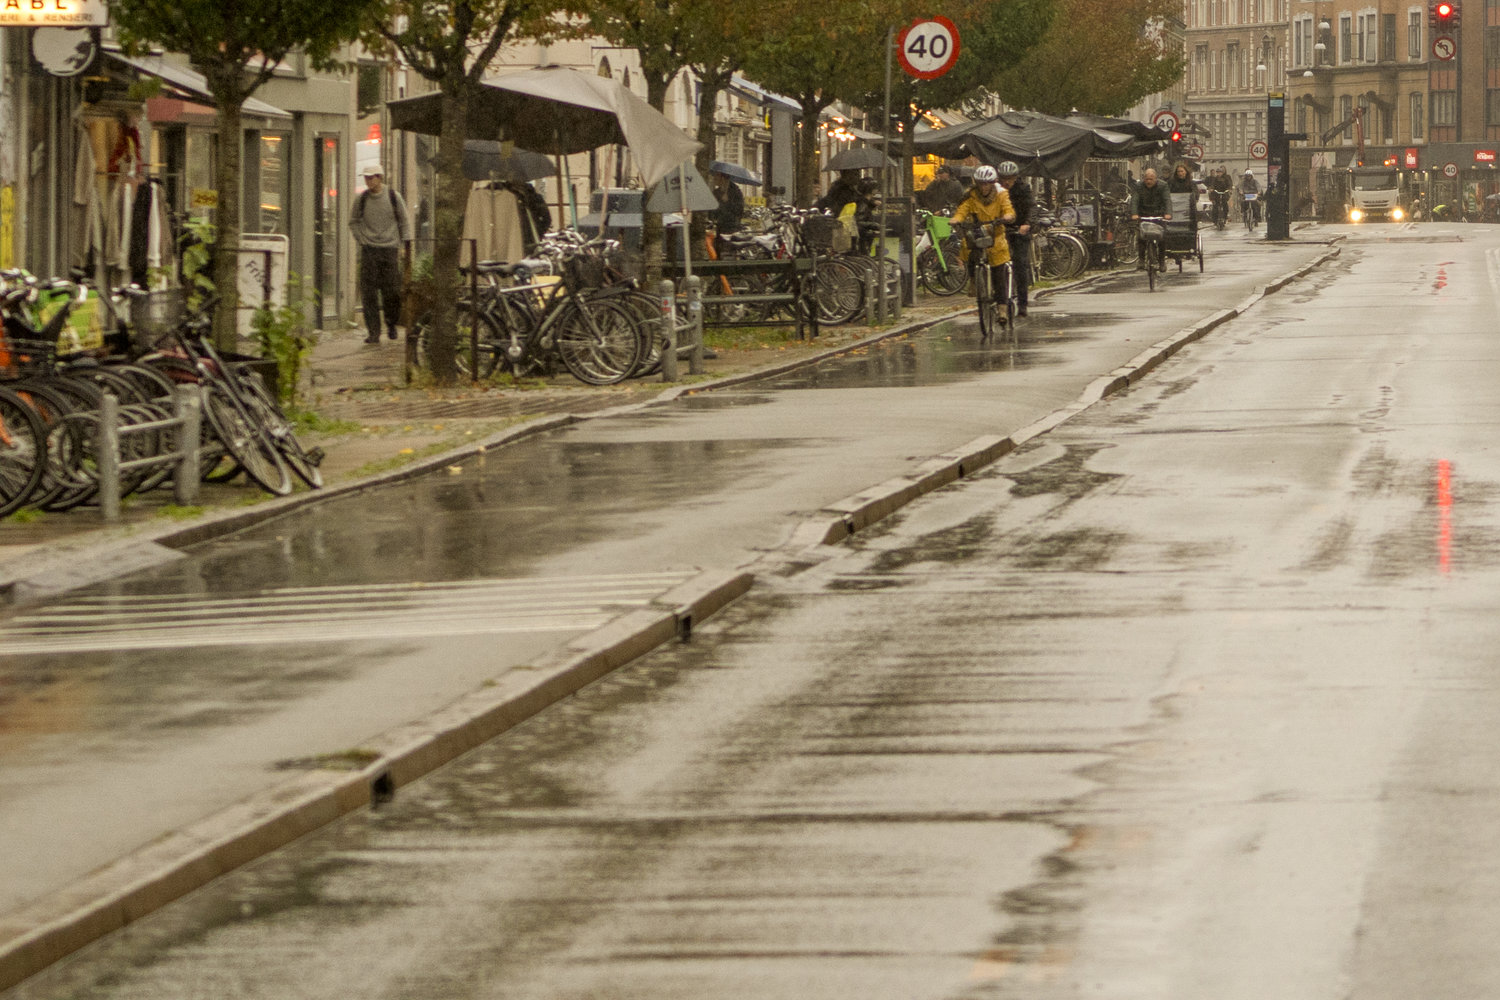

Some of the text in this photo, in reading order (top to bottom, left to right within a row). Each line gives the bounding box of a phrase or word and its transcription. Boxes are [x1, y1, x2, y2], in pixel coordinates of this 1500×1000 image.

[907, 34, 948, 58] 40
[1159, 118, 1174, 129] 40
[1253, 146, 1265, 154] 40
